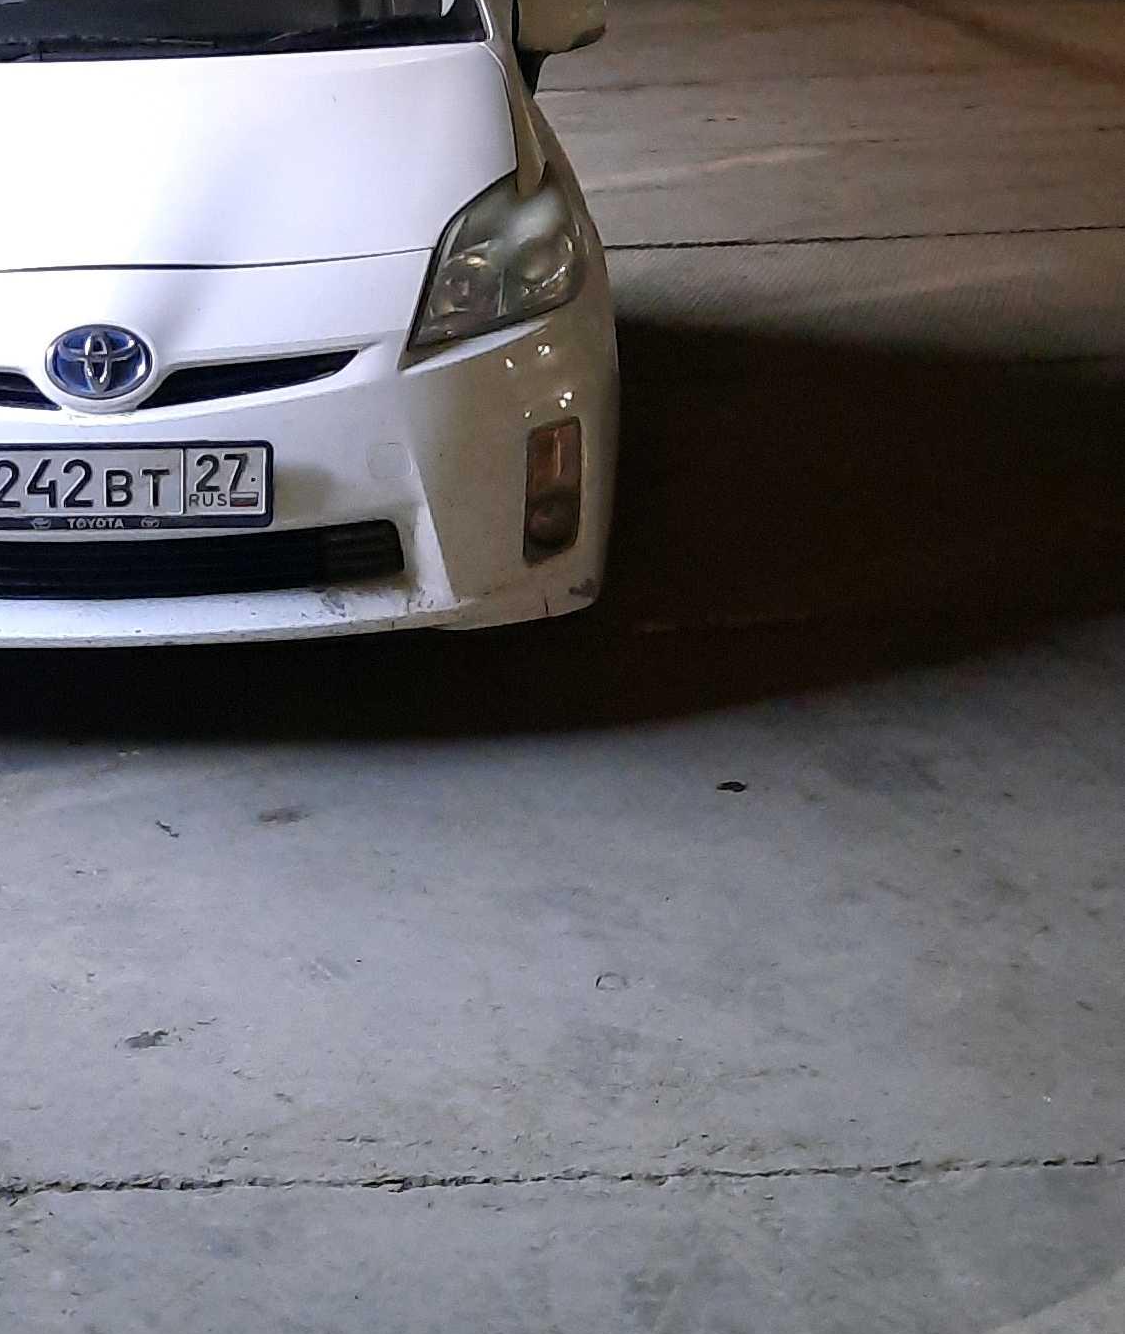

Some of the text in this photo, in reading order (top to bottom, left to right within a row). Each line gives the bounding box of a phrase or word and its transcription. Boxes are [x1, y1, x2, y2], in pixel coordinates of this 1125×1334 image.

[195, 453, 248, 492] 27
[188, 492, 228, 507] RUS
[67, 517, 125, 530] TOYOTA
